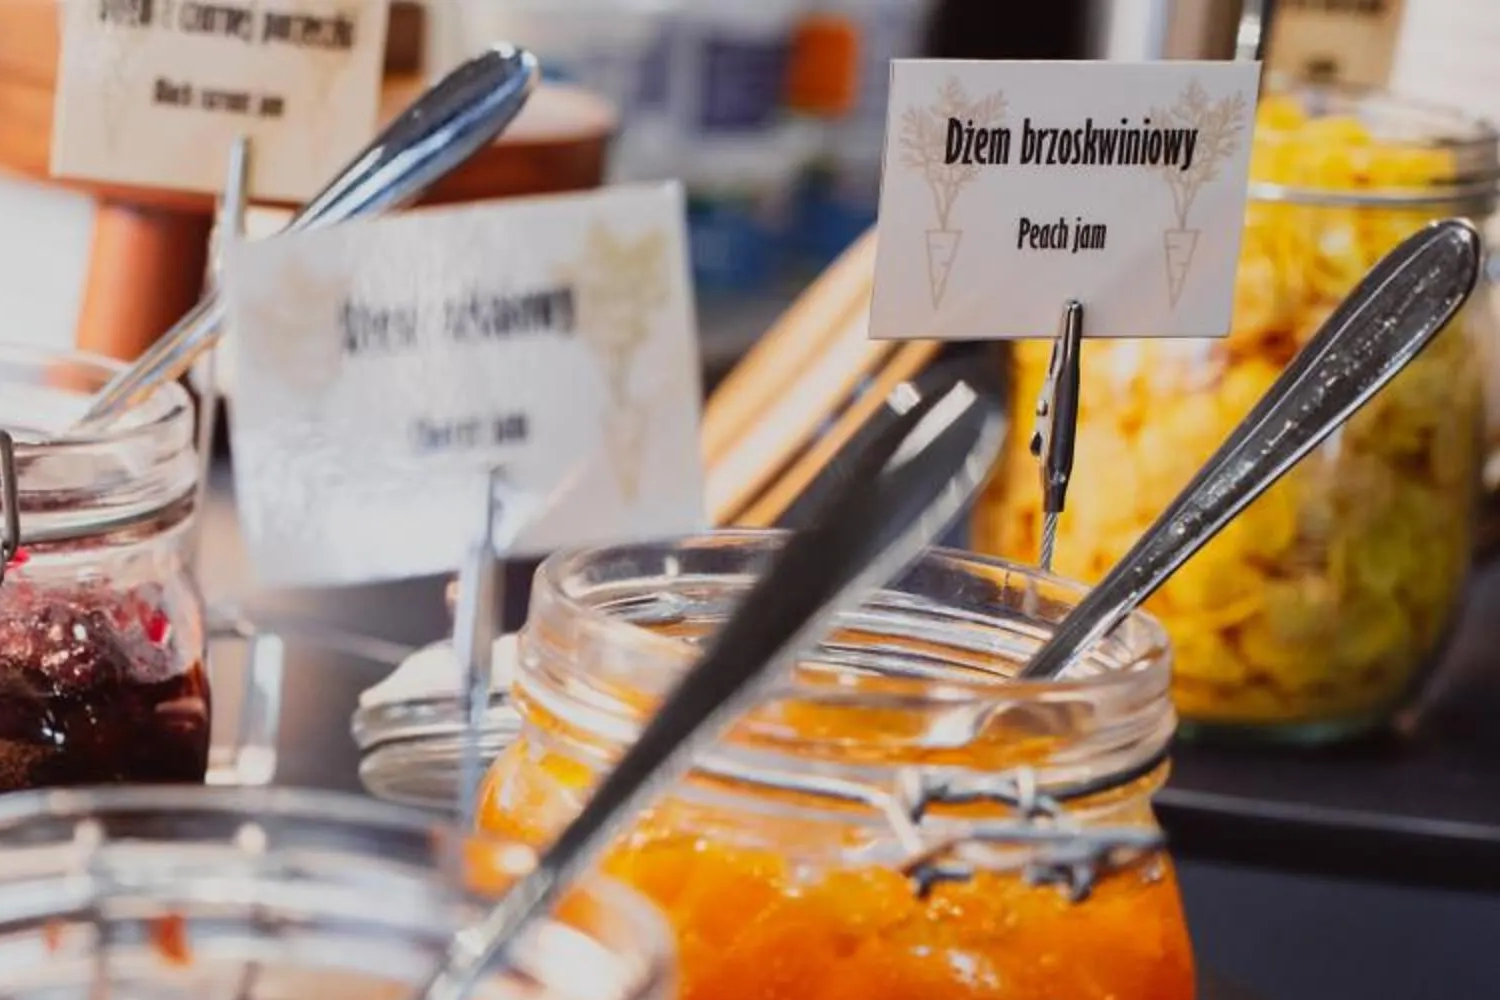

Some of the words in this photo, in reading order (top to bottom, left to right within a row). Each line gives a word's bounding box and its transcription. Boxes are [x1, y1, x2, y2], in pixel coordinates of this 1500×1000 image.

[945, 117, 1011, 166] Dżem
[1019, 118, 1198, 171] brzoskwiniowy
[1017, 217, 1067, 250] Peach
[1071, 218, 1107, 253] jam
